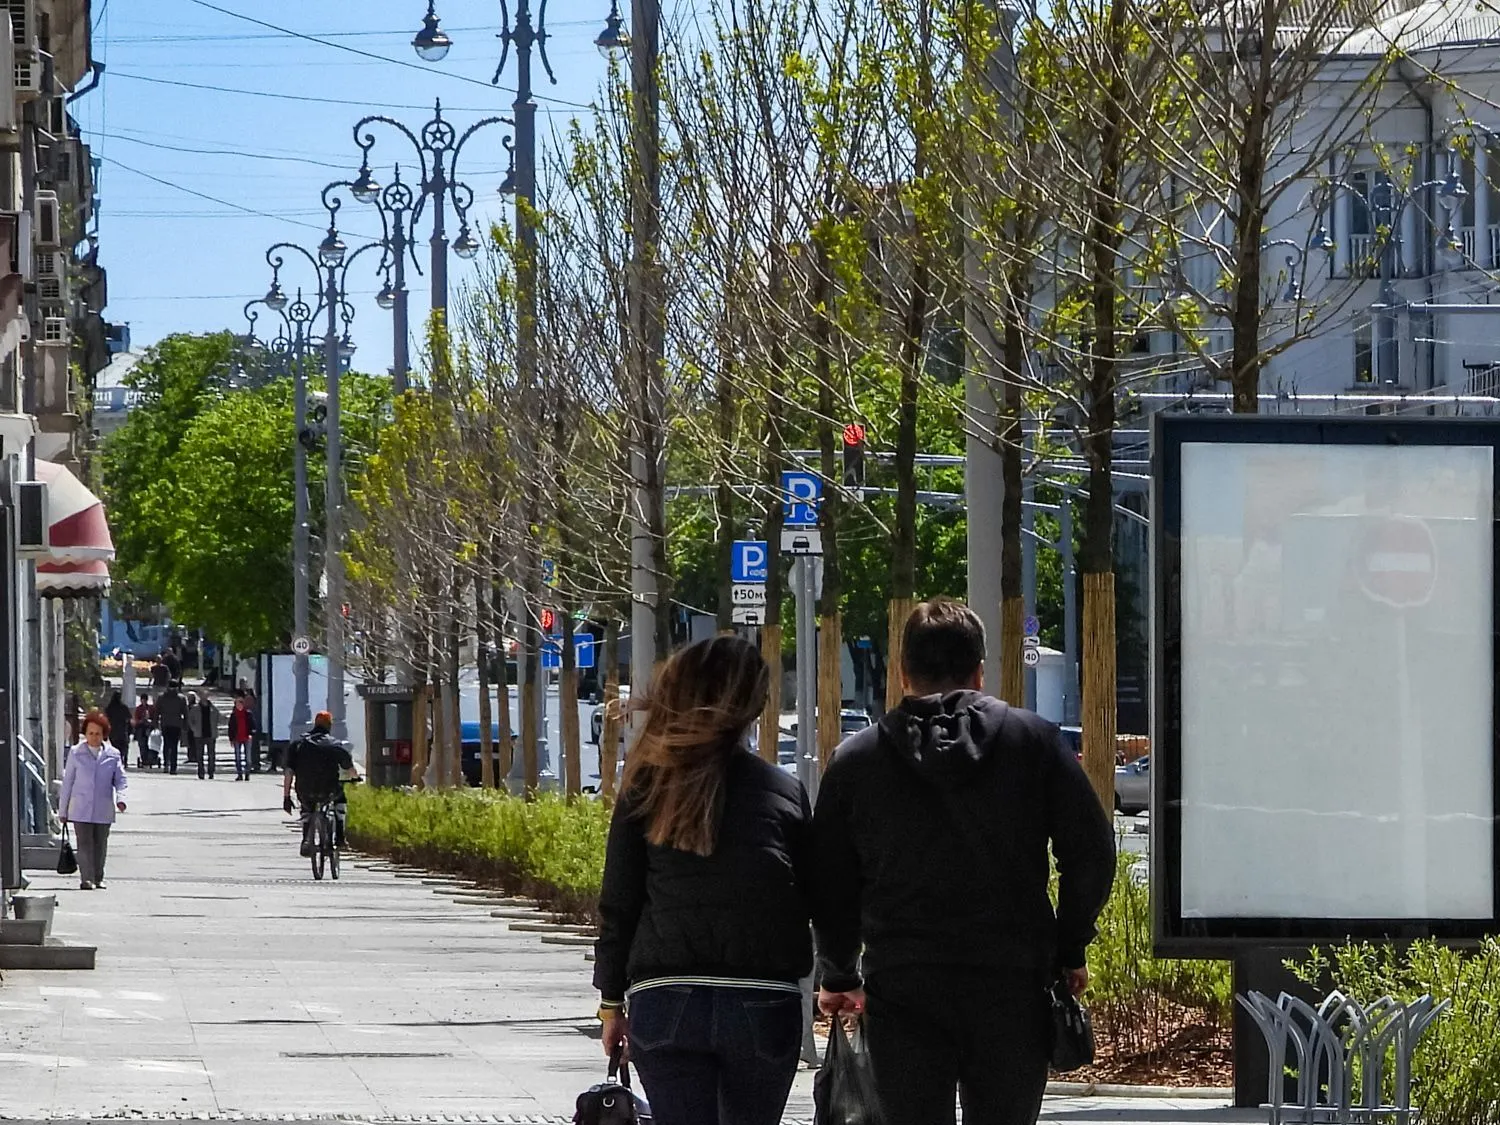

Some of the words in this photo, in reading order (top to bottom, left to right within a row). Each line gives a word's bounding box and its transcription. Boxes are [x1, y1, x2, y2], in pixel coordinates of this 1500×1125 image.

[788, 478, 817, 518] P
[742, 546, 764, 577] P
[296, 641, 308, 649] 40
[1025, 653, 1037, 661] 40
